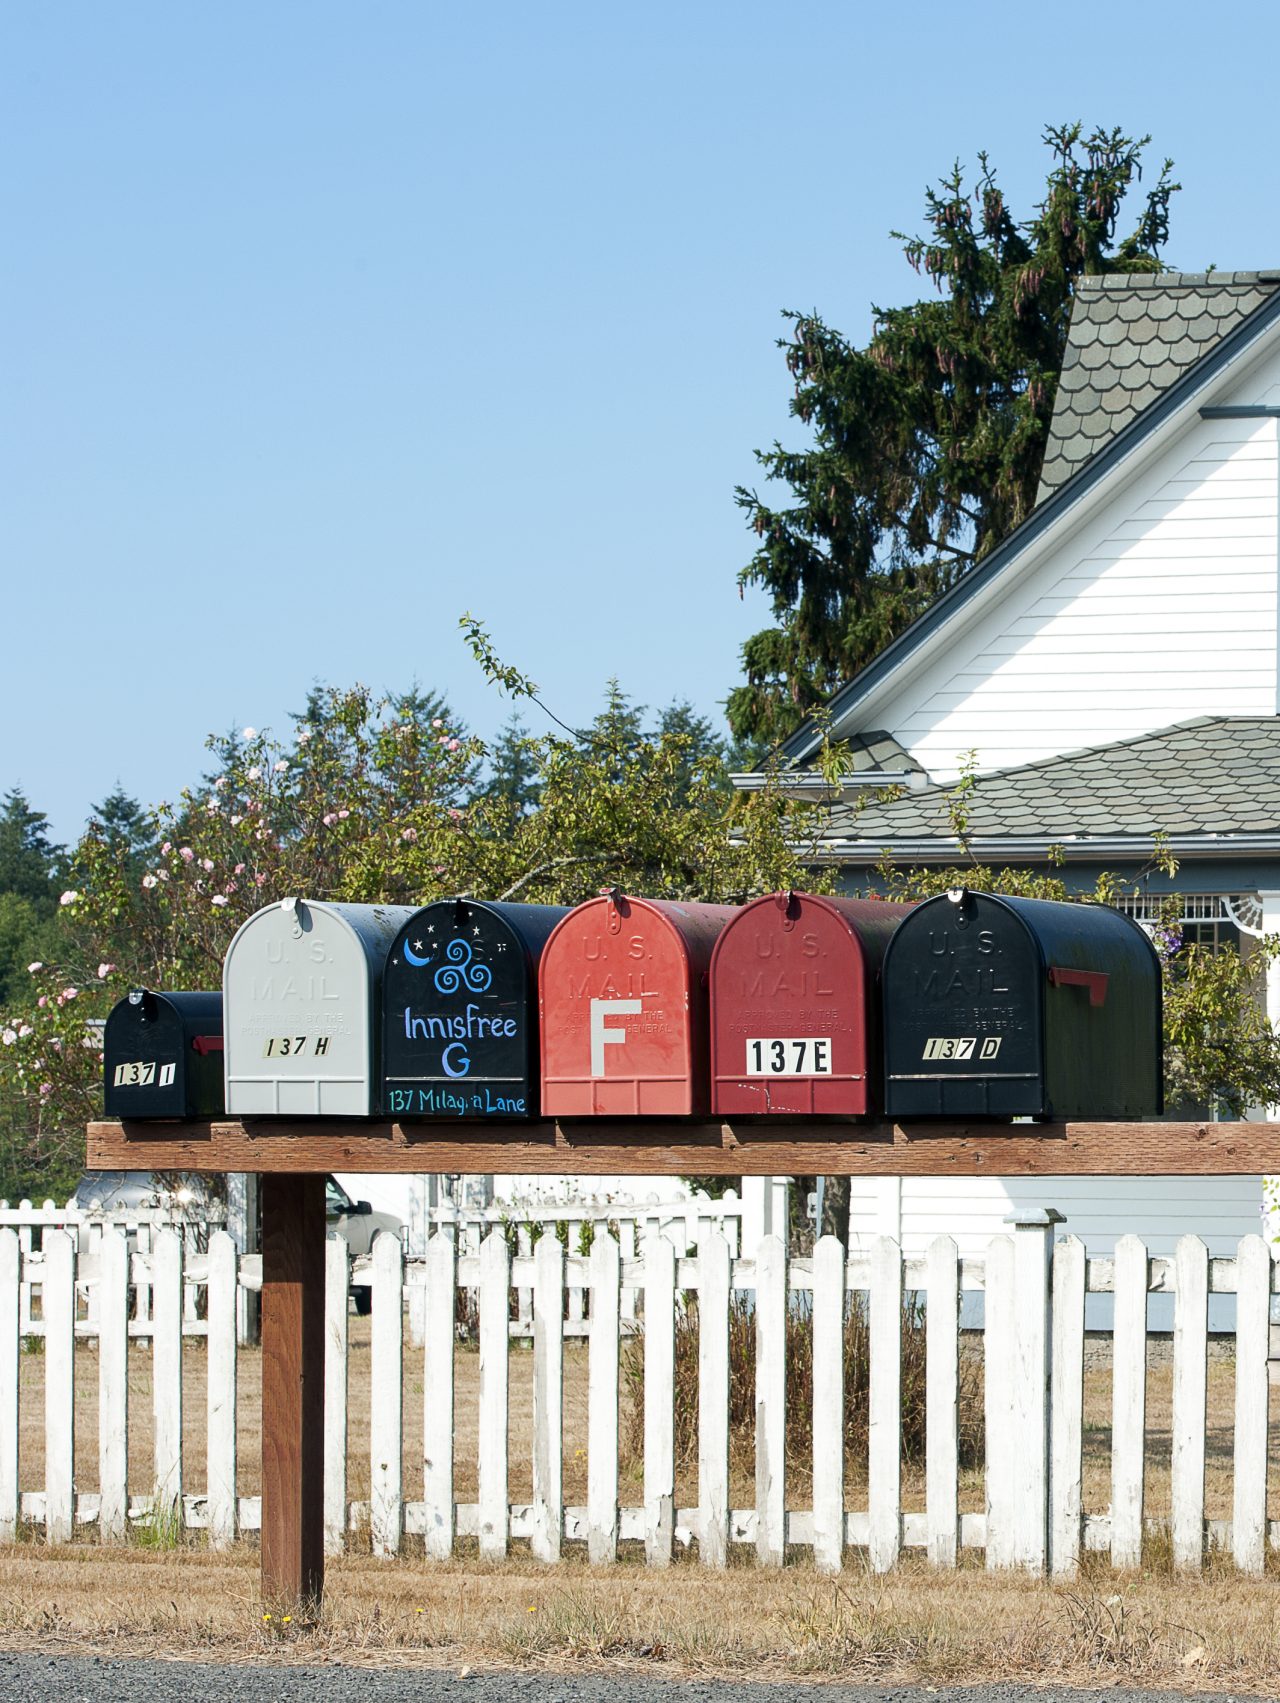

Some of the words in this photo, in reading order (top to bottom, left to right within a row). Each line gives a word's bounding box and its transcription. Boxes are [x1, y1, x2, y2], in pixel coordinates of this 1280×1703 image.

[251, 976, 341, 1001] MAIL
[568, 973, 660, 999] MAIL
[740, 971, 834, 997] MAIL
[913, 969, 1009, 996] MAIL
[405, 1003, 517, 1039] Innisfree
[267, 1036, 307, 1057] 137
[314, 1037, 330, 1056] H
[591, 998, 642, 1077] F
[928, 1039, 975, 1059] 137
[982, 1039, 1000, 1058] D
[441, 1042, 471, 1078] G
[752, 1041, 828, 1073] 137E
[119, 1064, 153, 1085] 137
[389, 1089, 414, 1112] 137
[419, 1089, 483, 1116] Milaga
[485, 1088, 526, 1113] Lane
